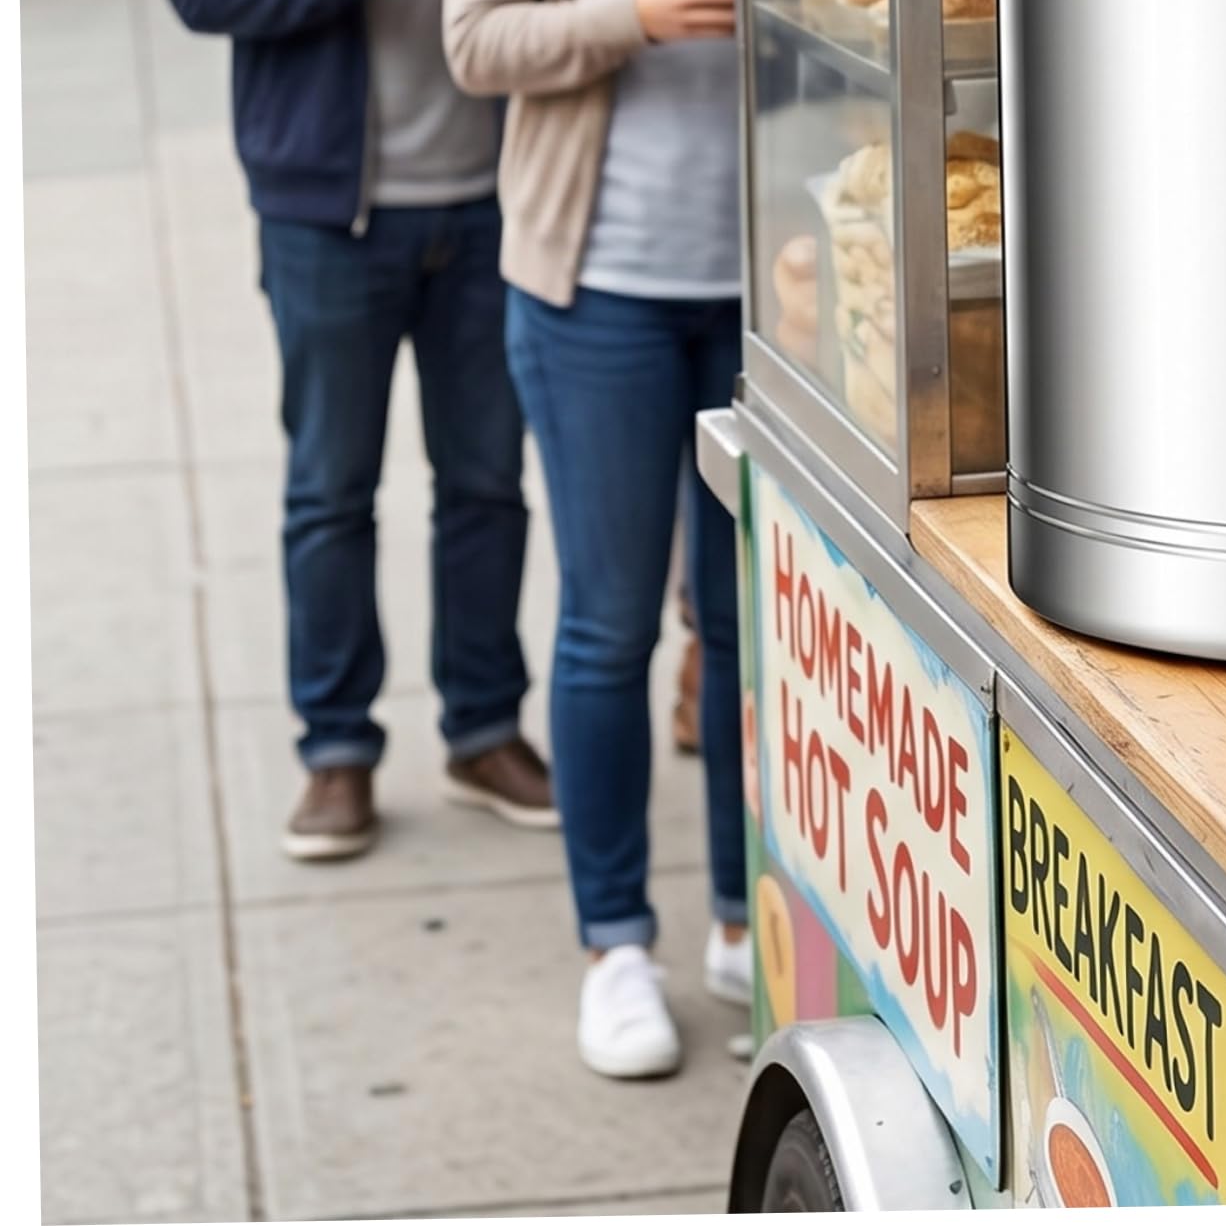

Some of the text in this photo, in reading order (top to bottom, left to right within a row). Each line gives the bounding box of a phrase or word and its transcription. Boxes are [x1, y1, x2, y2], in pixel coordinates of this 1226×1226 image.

[773, 520, 971, 876] HOMEMADE
[781, 678, 978, 1060] HOT SOUP
[1008, 774, 1223, 1143] BREAKFAST
